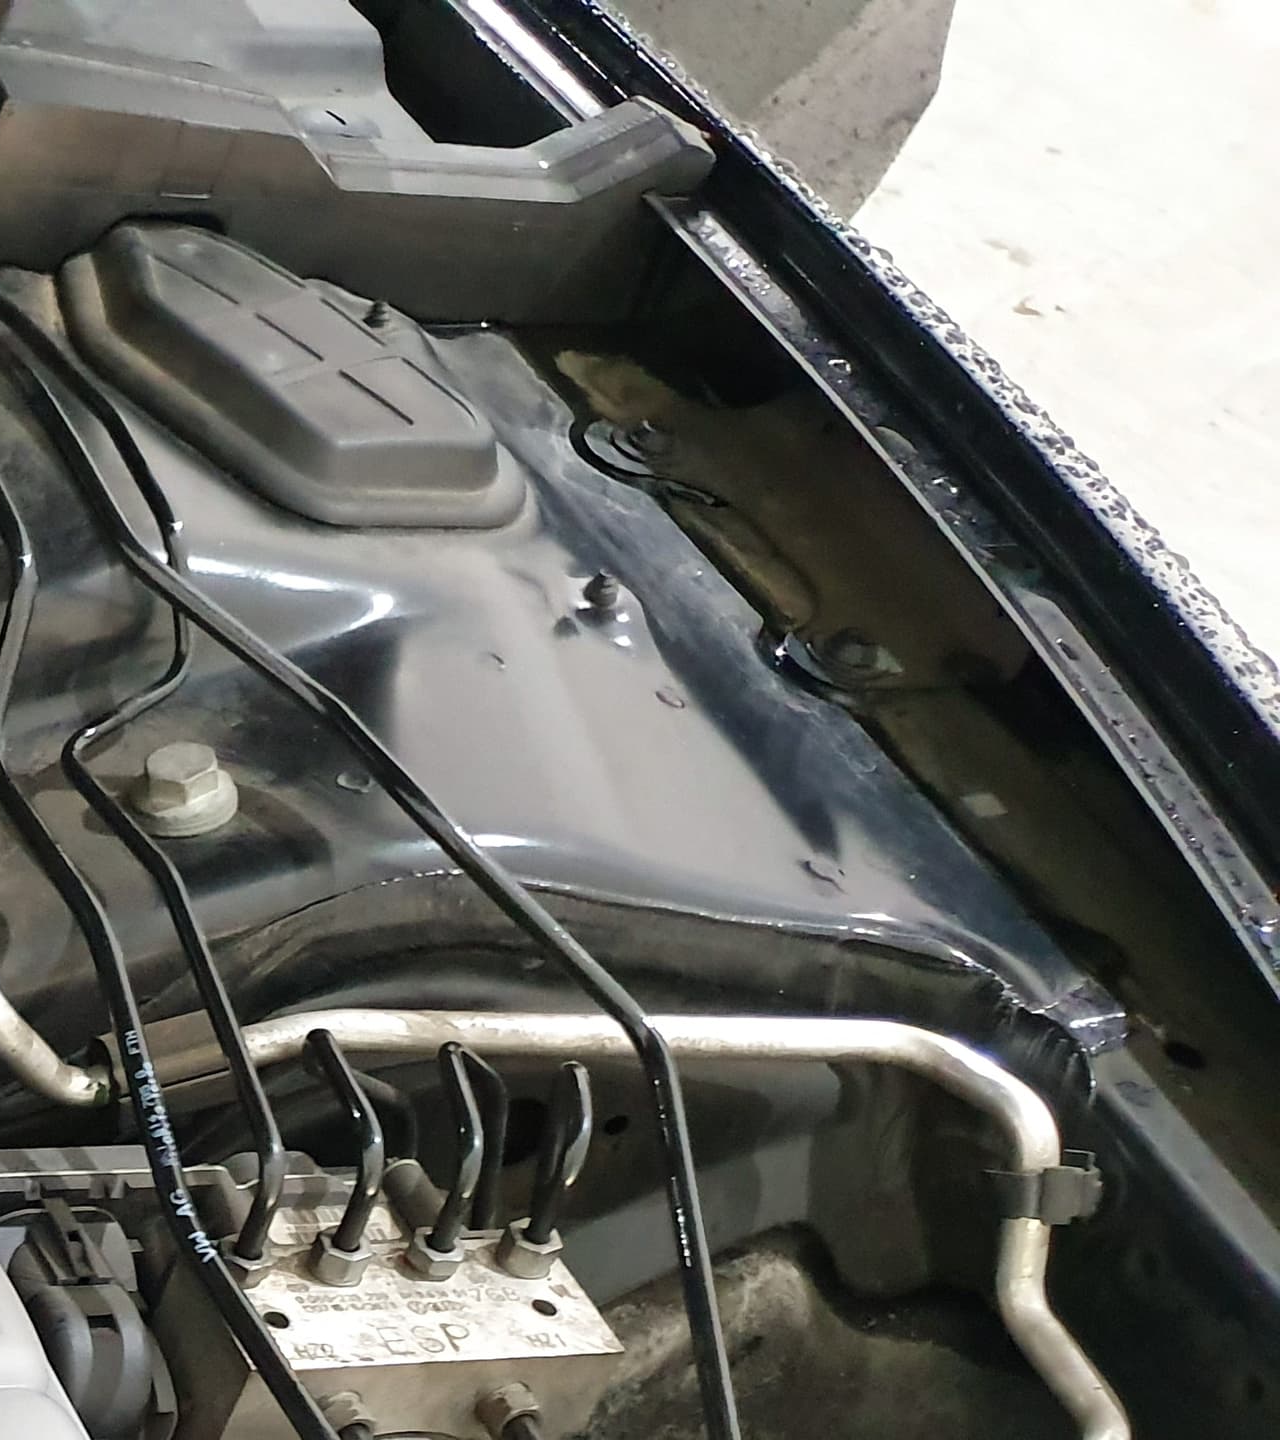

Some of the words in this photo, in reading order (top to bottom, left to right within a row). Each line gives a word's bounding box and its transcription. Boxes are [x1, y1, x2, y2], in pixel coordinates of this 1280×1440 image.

[170, 1188, 194, 1218] AG
[188, 1231, 217, 1263] VW
[378, 1322, 471, 1356] ESP
